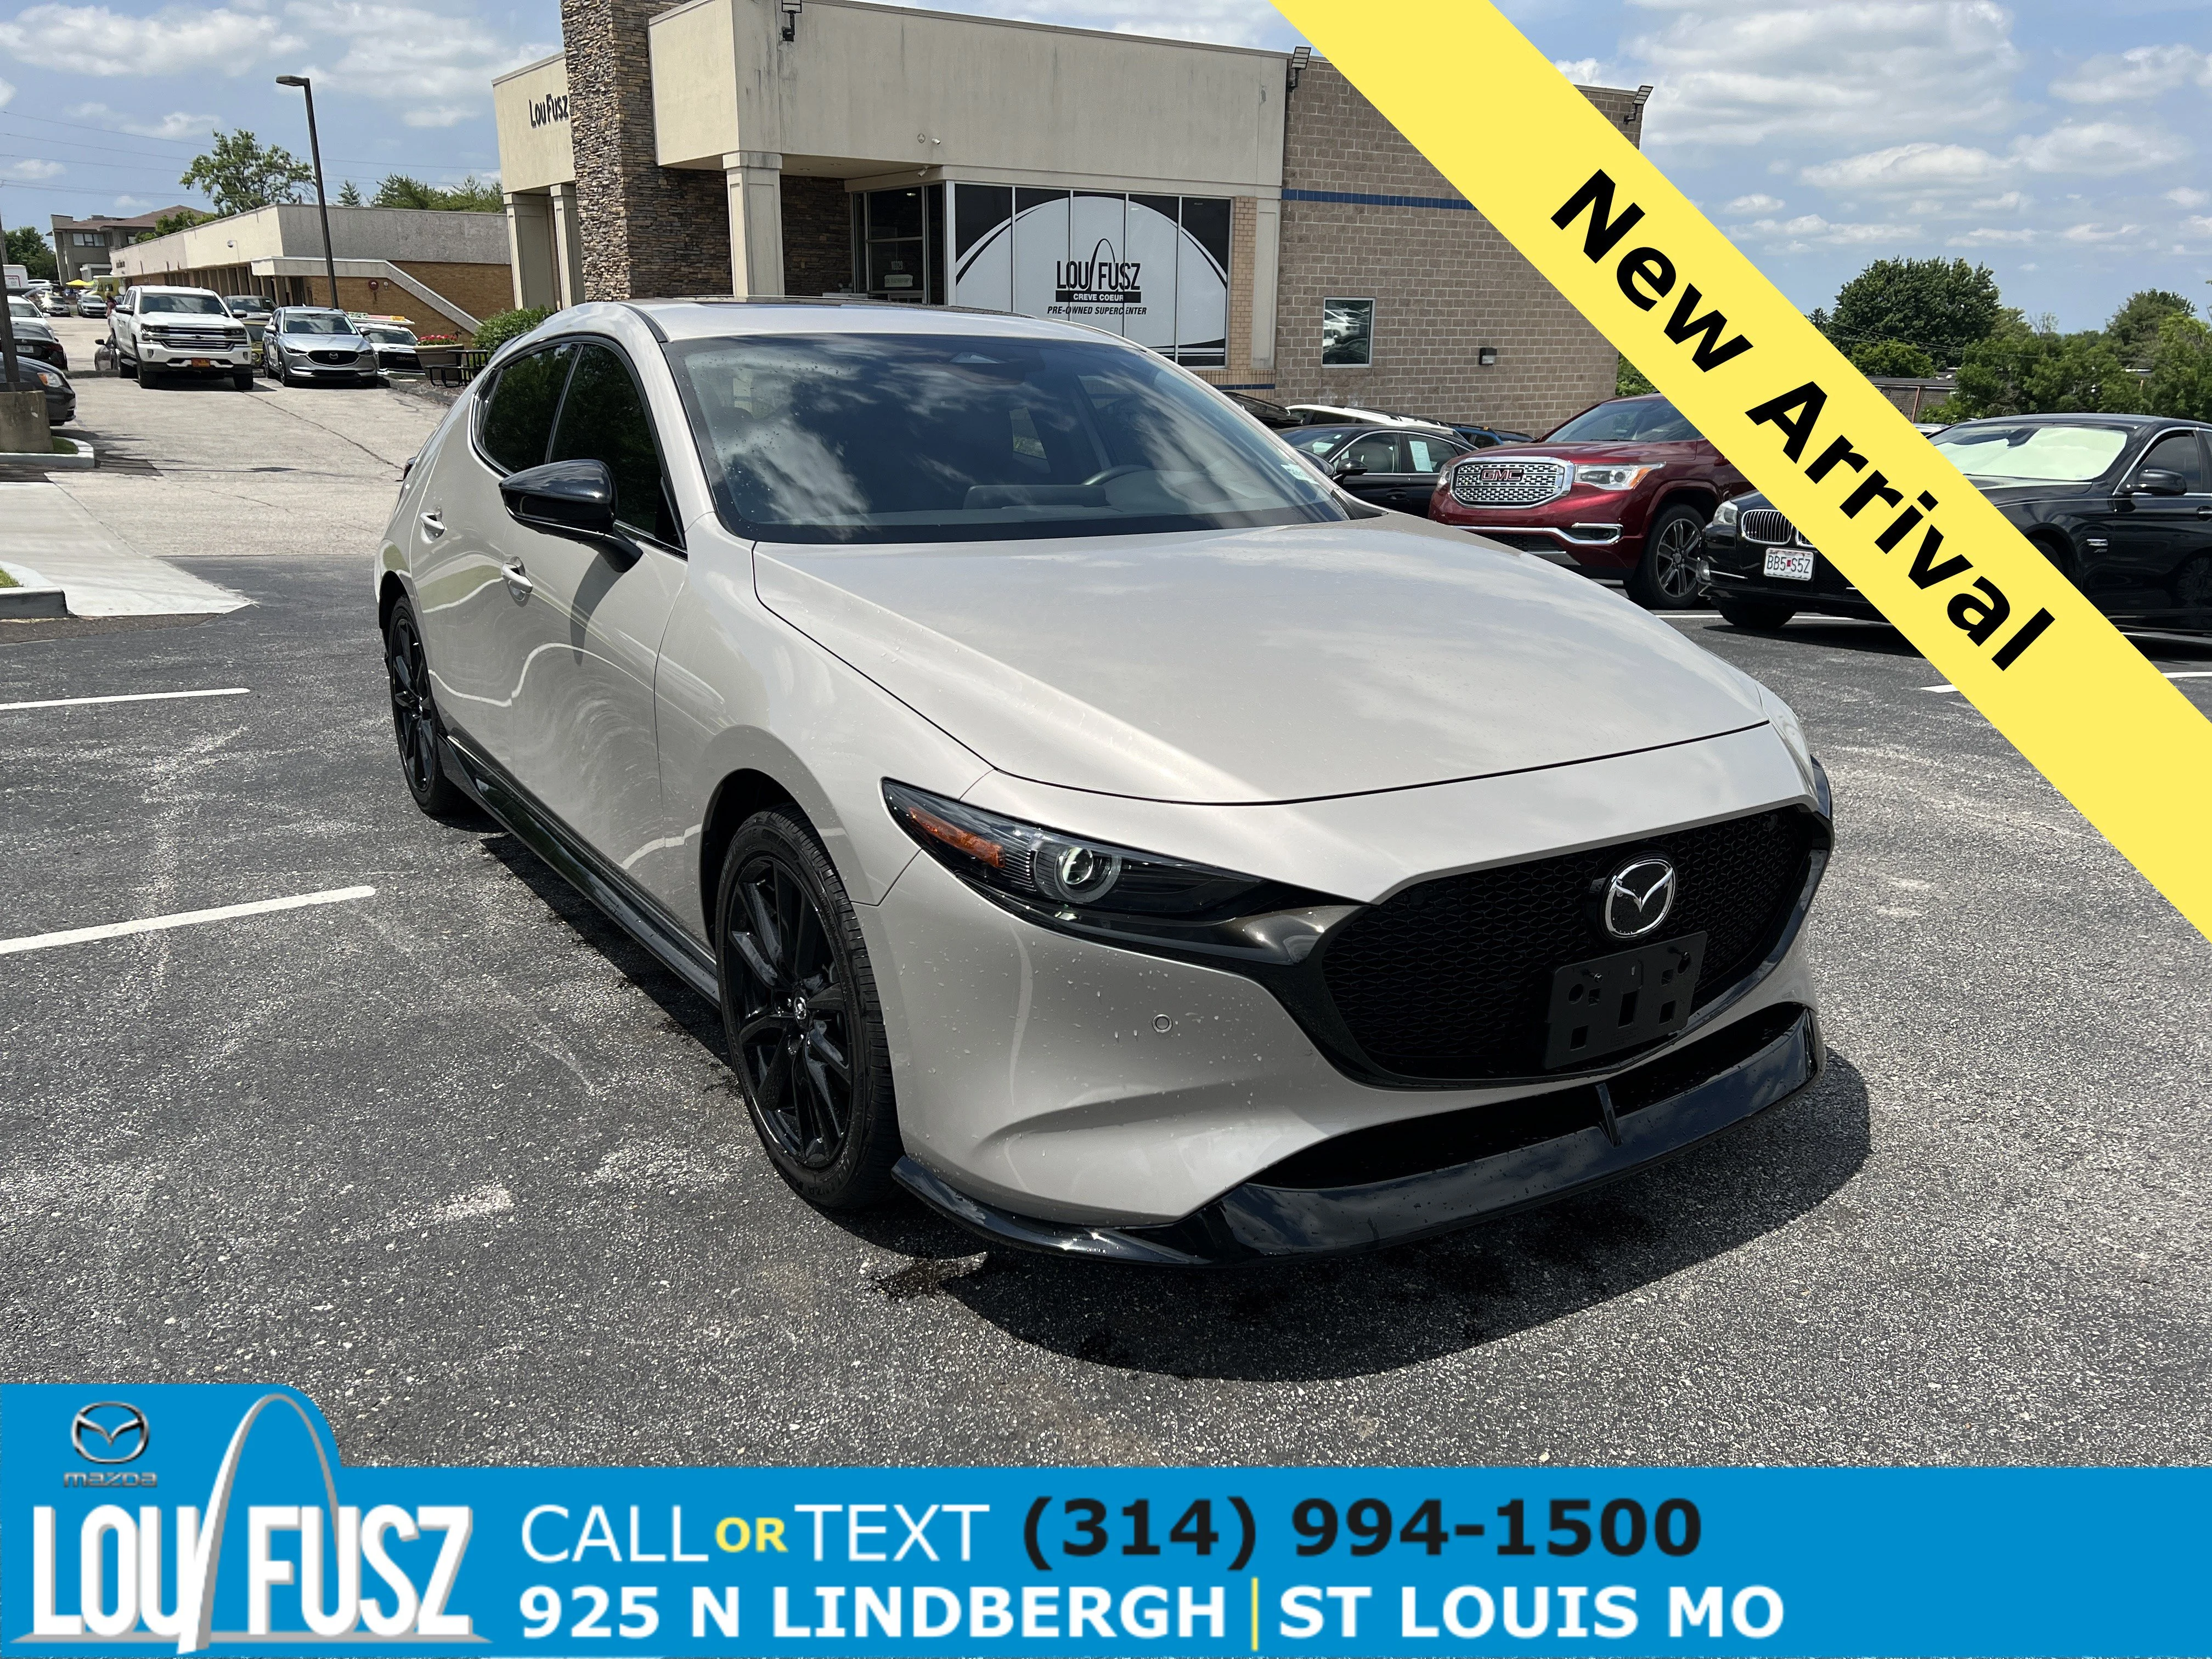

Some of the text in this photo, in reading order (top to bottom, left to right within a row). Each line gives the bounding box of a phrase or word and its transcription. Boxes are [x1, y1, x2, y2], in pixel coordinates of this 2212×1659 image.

[1057, 261, 1141, 290] LOU FUSZ
[1099, 294, 1124, 302] COEUR
[1047, 306, 1147, 315] PRE-OWNED SUPERCENTER
[1481, 469, 1522, 481] GMC
